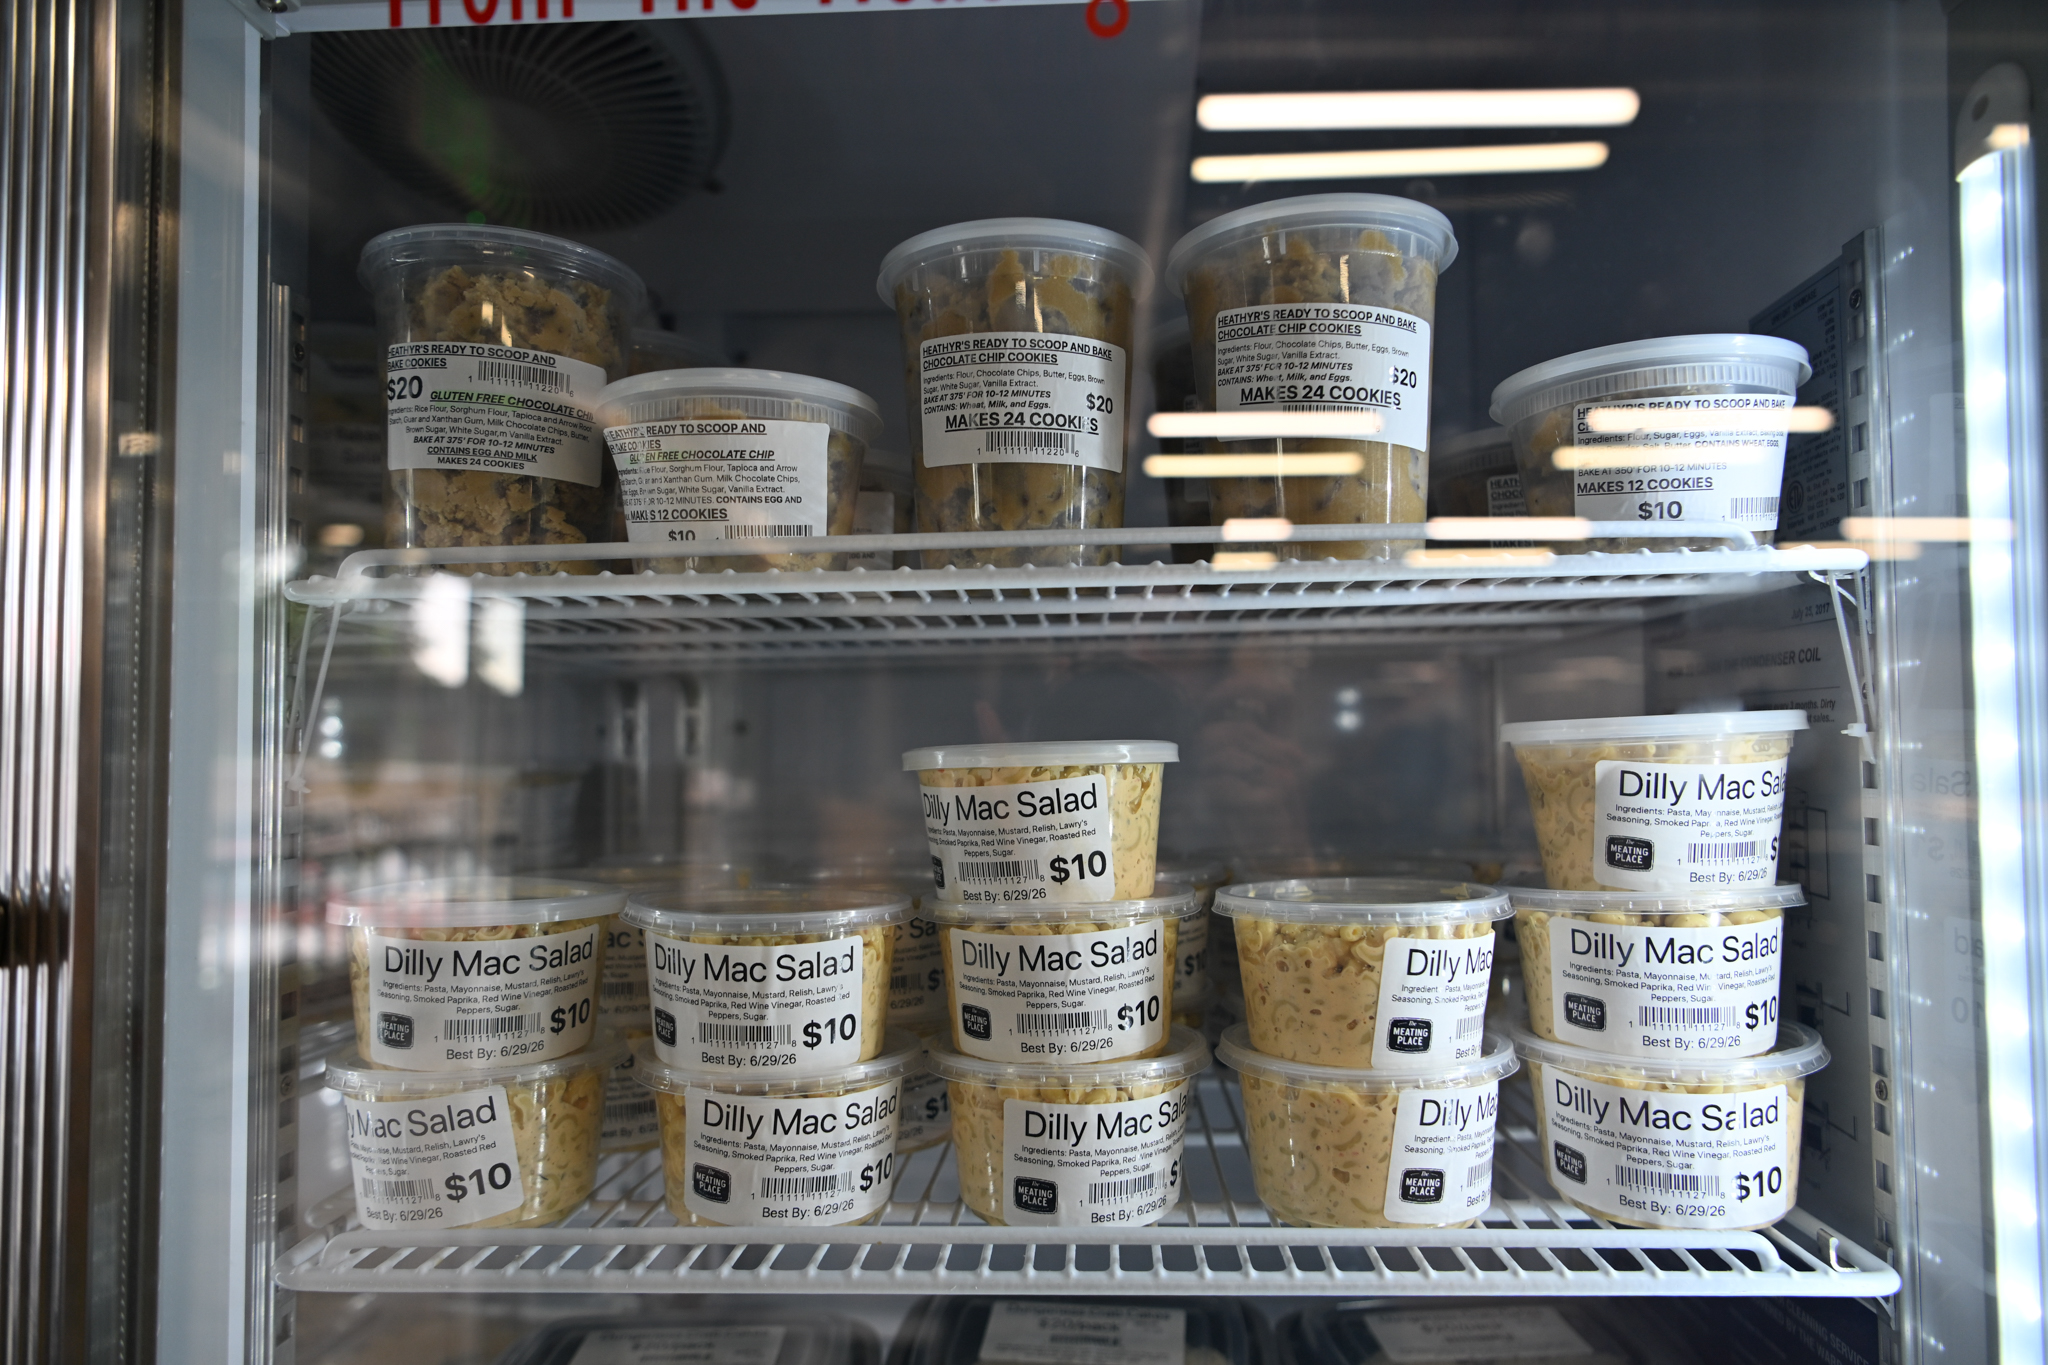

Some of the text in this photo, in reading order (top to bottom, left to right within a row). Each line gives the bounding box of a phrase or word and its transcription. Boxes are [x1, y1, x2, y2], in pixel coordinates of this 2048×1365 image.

[1218, 308, 1416, 331] HEATHYR'S READY TO SCOOP AND BAKE
[1218, 323, 1361, 339] CHOCOLATE CHIP COOKIES
[388, 345, 556, 365] HEATHYR'S READY TO SCOOP AND
[923, 338, 1112, 359] HEATHYR'S READY TO SCOOP AND BAKE
[388, 358, 447, 369] BAKE COOKIES
[923, 353, 1058, 370] CHOCOLATE CHIP COOKIES
[1389, 366, 1417, 388] $20
[388, 375, 423, 402] $20
[924, 395, 938, 404] BAKE
[939, 394, 948, 402] AT
[967, 391, 983, 399] FOR
[1011, 390, 1051, 398] MINUTES
[1241, 385, 1401, 406] MAKES 24 COOKIES
[430, 391, 574, 416] GLUTEN FREE CHOCOLATE
[924, 403, 958, 414] CONTAINS:
[988, 401, 1008, 409] Milk,
[1029, 401, 1051, 410] Eggs.
[1087, 392, 1113, 414] $20
[646, 424, 766, 435] READY TO SCOOP AND
[946, 413, 999, 429] MAKES
[1004, 412, 1025, 425] 24
[438, 456, 525, 470] MAKES 24 COOKIES
[657, 452, 679, 460] FREE
[681, 451, 746, 459] CHOCOLATE
[1577, 477, 1713, 493] MAKES 12 COOKIES
[658, 509, 669, 520] 12
[671, 509, 728, 519] COOKIES
[1638, 501, 1682, 521] $10
[668, 530, 696, 541] $10
[1815, 602, 1830, 615] 2017
[1798, 647, 1821, 663] COIL
[1821, 699, 1835, 711] Dirty
[1619, 770, 1786, 806] Dilly Mac Sala
[923, 783, 1097, 826] Dilly Mac Salad
[1611, 844, 1649, 856] MEATING
[1615, 853, 1643, 864] PLACE
[1050, 850, 1107, 885] $10
[964, 888, 1046, 903] Best By: 6/29/26
[962, 939, 1010, 976] Dilly
[1019, 944, 1082, 972] Mac
[1090, 929, 1157, 968] Salad
[1571, 926, 1778, 967] Dilly Mac Salad
[385, 933, 594, 982] Dilly Mac Salad
[655, 943, 854, 983] Dilly Mac Salad
[1407, 948, 1461, 982] Dilly
[996, 966, 1150, 988] Pasta, Mayonnaise, Mustard, Relish, Lawry's
[550, 998, 590, 1036] $10
[1118, 995, 1159, 1031] $10
[1745, 995, 1777, 1031] $10
[803, 1013, 857, 1050] $10
[1393, 1027, 1428, 1037] MEATING
[1397, 1036, 1423, 1046] PLACE
[1021, 1037, 1113, 1055] Best By: 6/29/26
[1642, 1035, 1741, 1051] Best By: 6/29/26
[702, 1052, 796, 1068] Best By: 6/29/26
[704, 1099, 763, 1140] Dilly
[773, 1108, 837, 1135] Mac
[845, 1087, 897, 1130] Salad
[1420, 1099, 1472, 1131] Dilly
[1556, 1079, 1779, 1132] Dilly Mac Salad
[357, 1096, 496, 1138] Mac Salad
[1025, 1092, 1189, 1147] Dilly Mac Sala
[445, 1162, 511, 1203] $10
[860, 1153, 893, 1193] $10
[1406, 1178, 1440, 1187] MEATING
[1018, 1186, 1053, 1199] MEATING
[1410, 1186, 1435, 1196] PLACE
[1732, 1166, 1782, 1203] $10
[762, 1199, 854, 1219] Best By: 6/29/26
[1022, 1195, 1048, 1206] PLACE
[1620, 1195, 1725, 1217] Best By: 6/29/26
